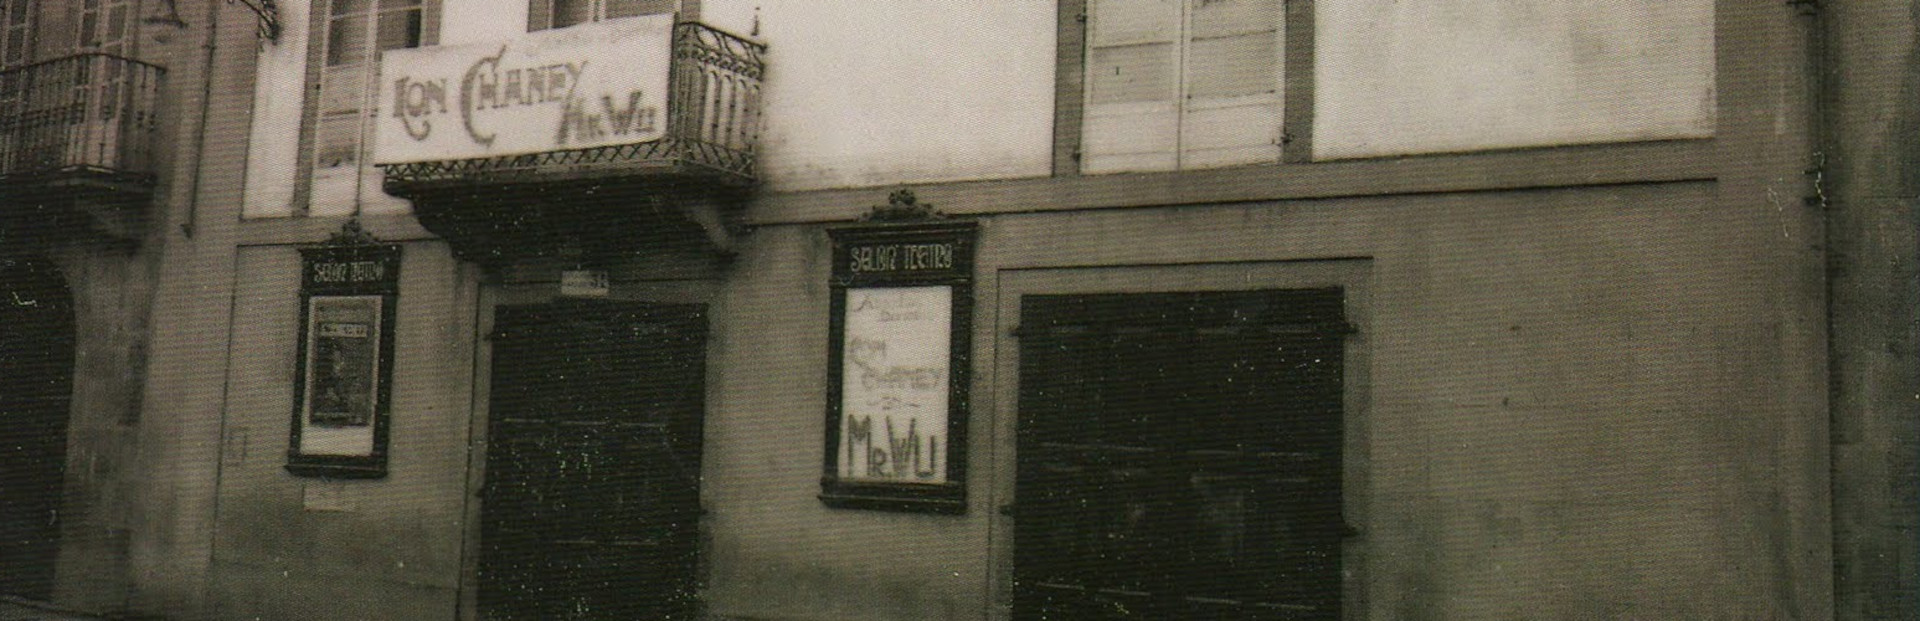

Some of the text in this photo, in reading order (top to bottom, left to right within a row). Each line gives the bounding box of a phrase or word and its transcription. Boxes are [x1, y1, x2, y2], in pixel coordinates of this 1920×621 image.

[393, 45, 588, 148] LON CHANEY
[602, 91, 656, 136] WU
[904, 244, 953, 270] TEATRO
[886, 415, 936, 478] WU
